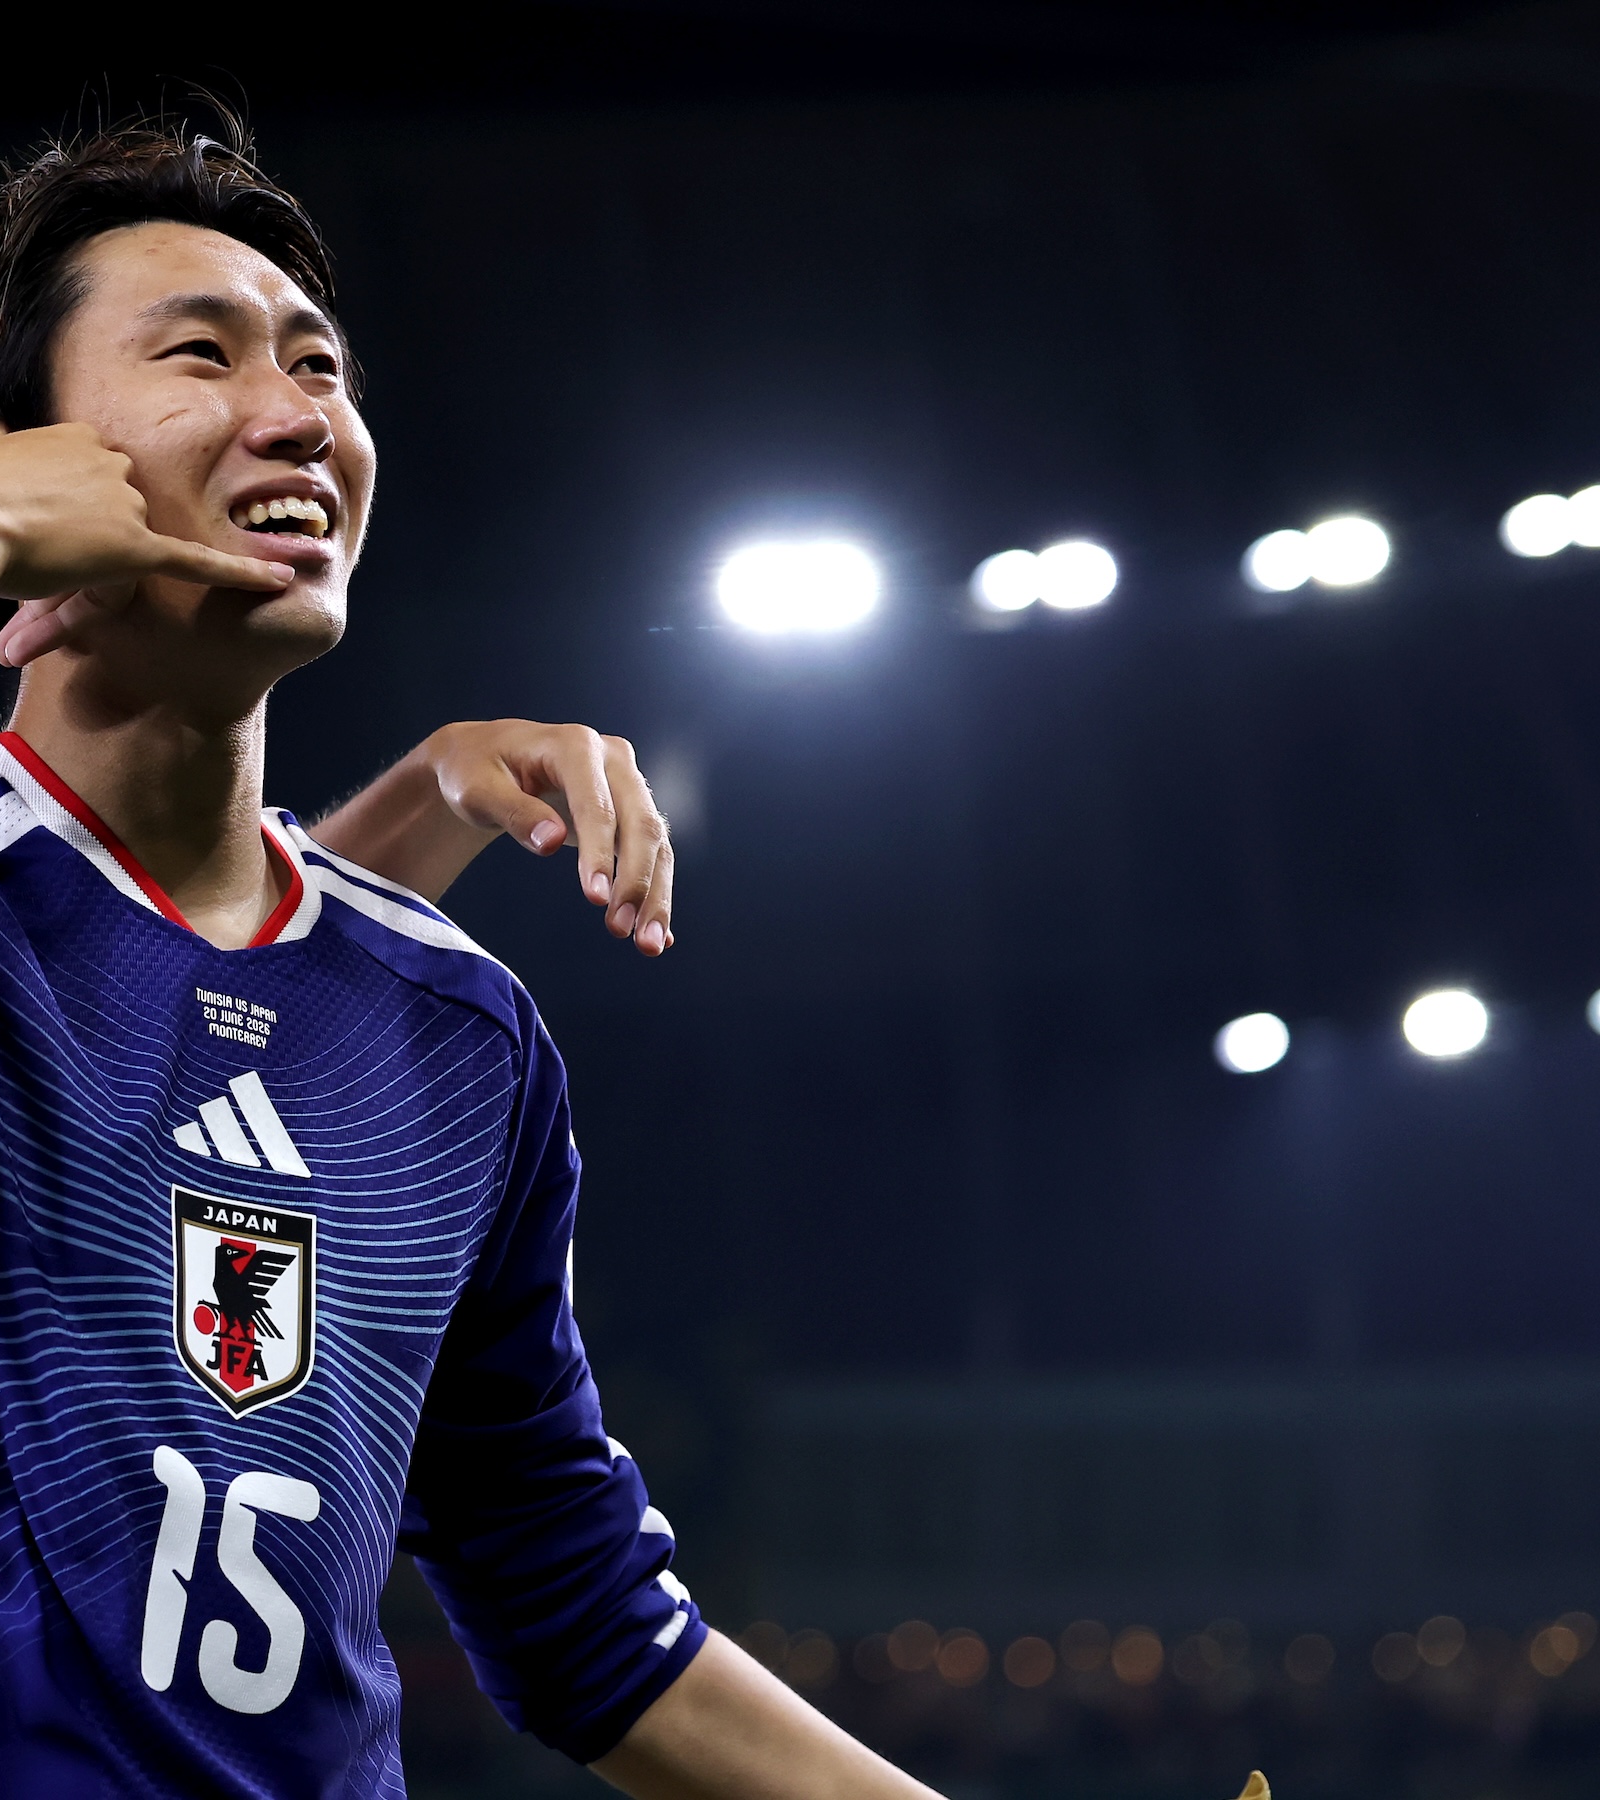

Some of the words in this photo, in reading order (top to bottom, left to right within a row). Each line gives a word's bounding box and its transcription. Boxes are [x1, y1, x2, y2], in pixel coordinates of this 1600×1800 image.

[196, 987, 233, 1008] TUNISIA
[250, 1003, 277, 1023] JAPAN
[203, 1006, 217, 1020] 20
[220, 1010, 244, 1027] JUNE
[246, 1017, 271, 1035] 2026
[208, 1023, 267, 1049] MONTERREY
[203, 1206, 277, 1233] JAPAN
[206, 1340, 269, 1381] JFA
[141, 1445, 320, 1714] 15
